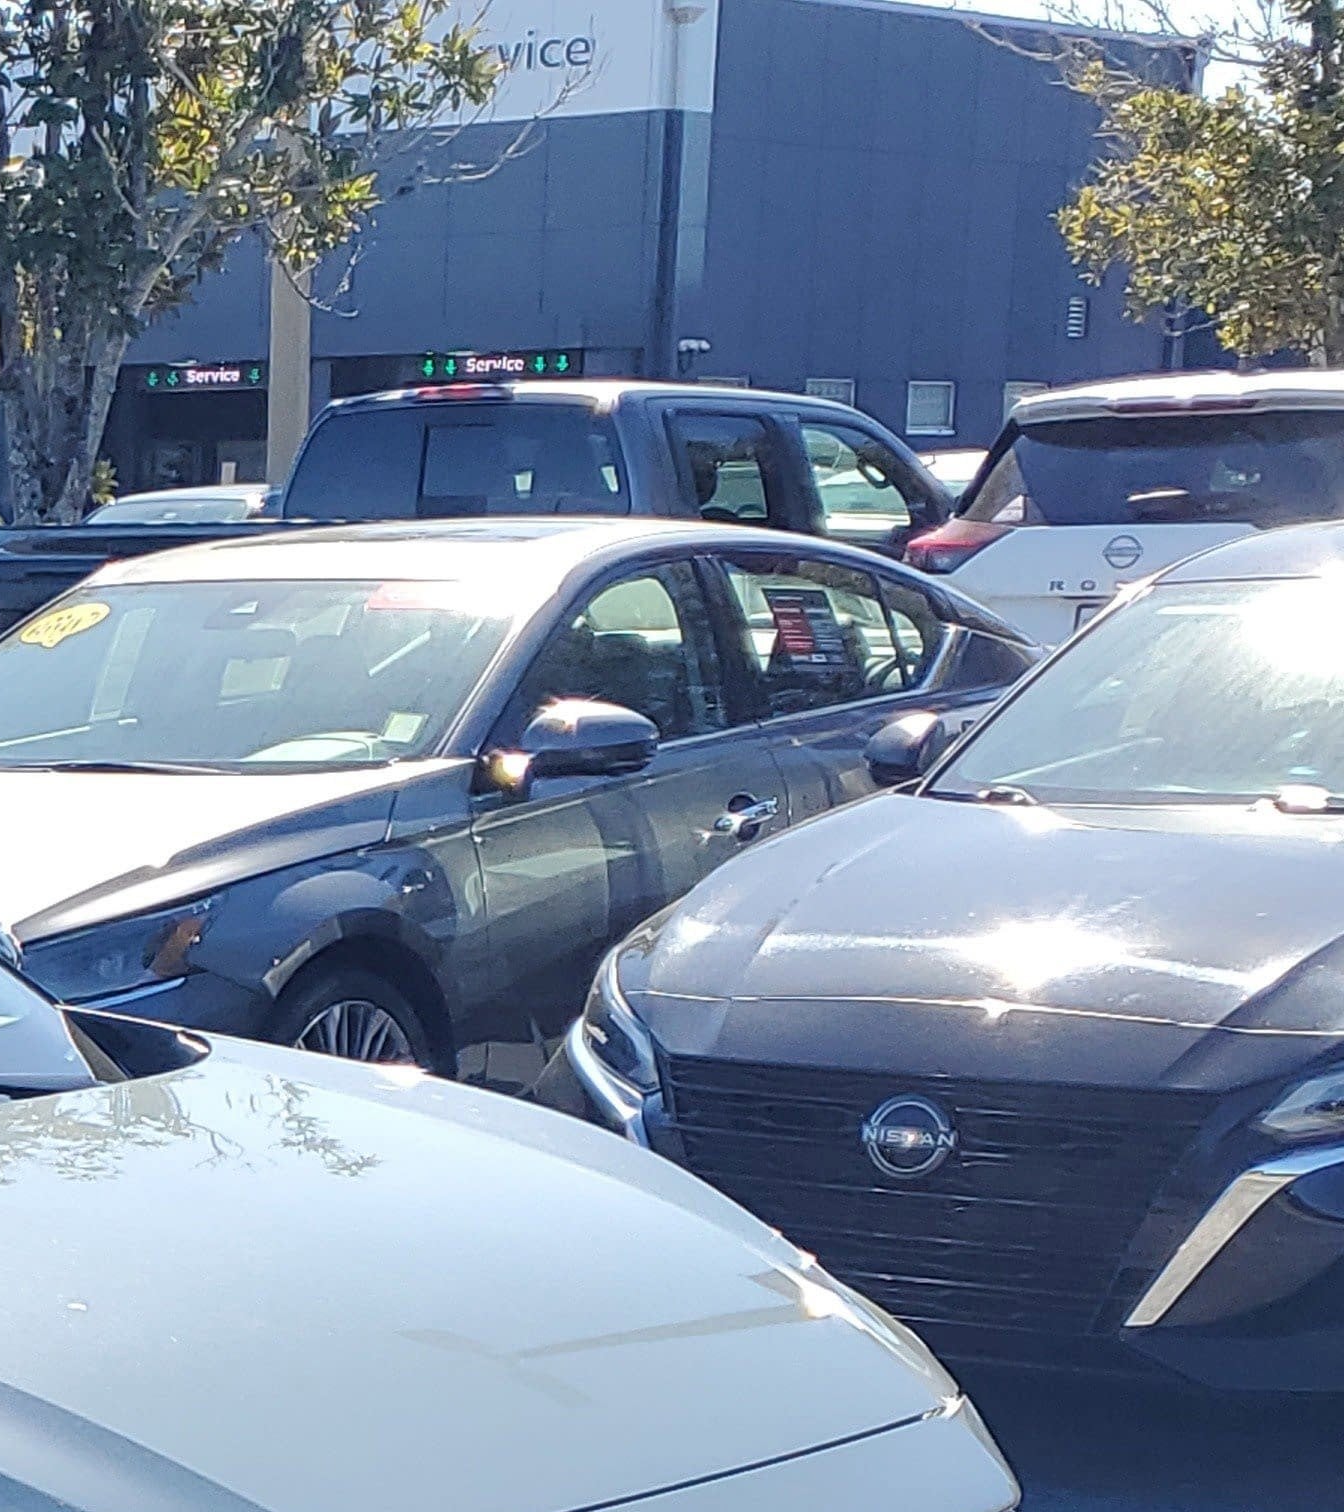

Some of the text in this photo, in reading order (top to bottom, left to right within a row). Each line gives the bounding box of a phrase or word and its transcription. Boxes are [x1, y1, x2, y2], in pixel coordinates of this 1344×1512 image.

[497, 30, 591, 70] vice
[465, 357, 525, 373] Service
[186, 366, 241, 384] Service
